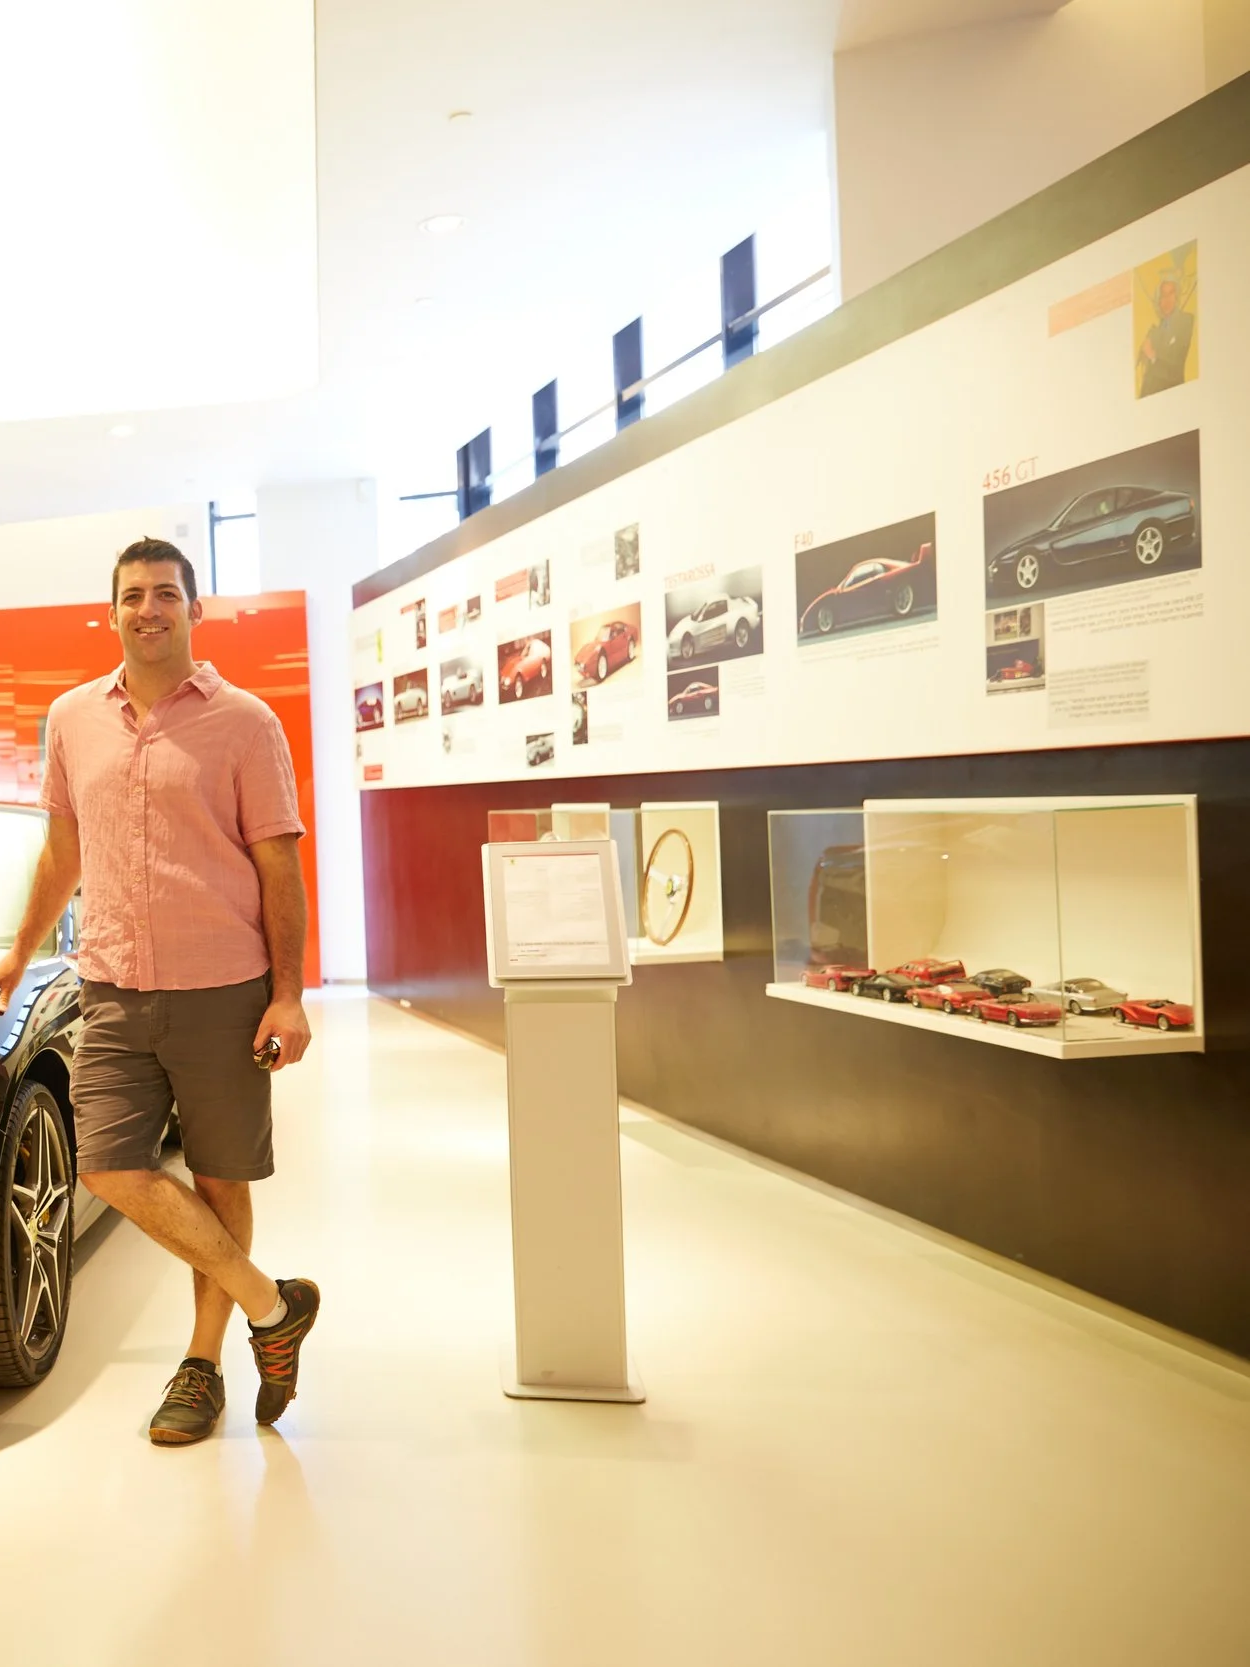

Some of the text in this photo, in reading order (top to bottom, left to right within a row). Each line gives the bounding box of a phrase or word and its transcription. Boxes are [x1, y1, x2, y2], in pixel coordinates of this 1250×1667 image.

[982, 455, 1040, 490] 456 GT
[794, 528, 814, 551] F40
